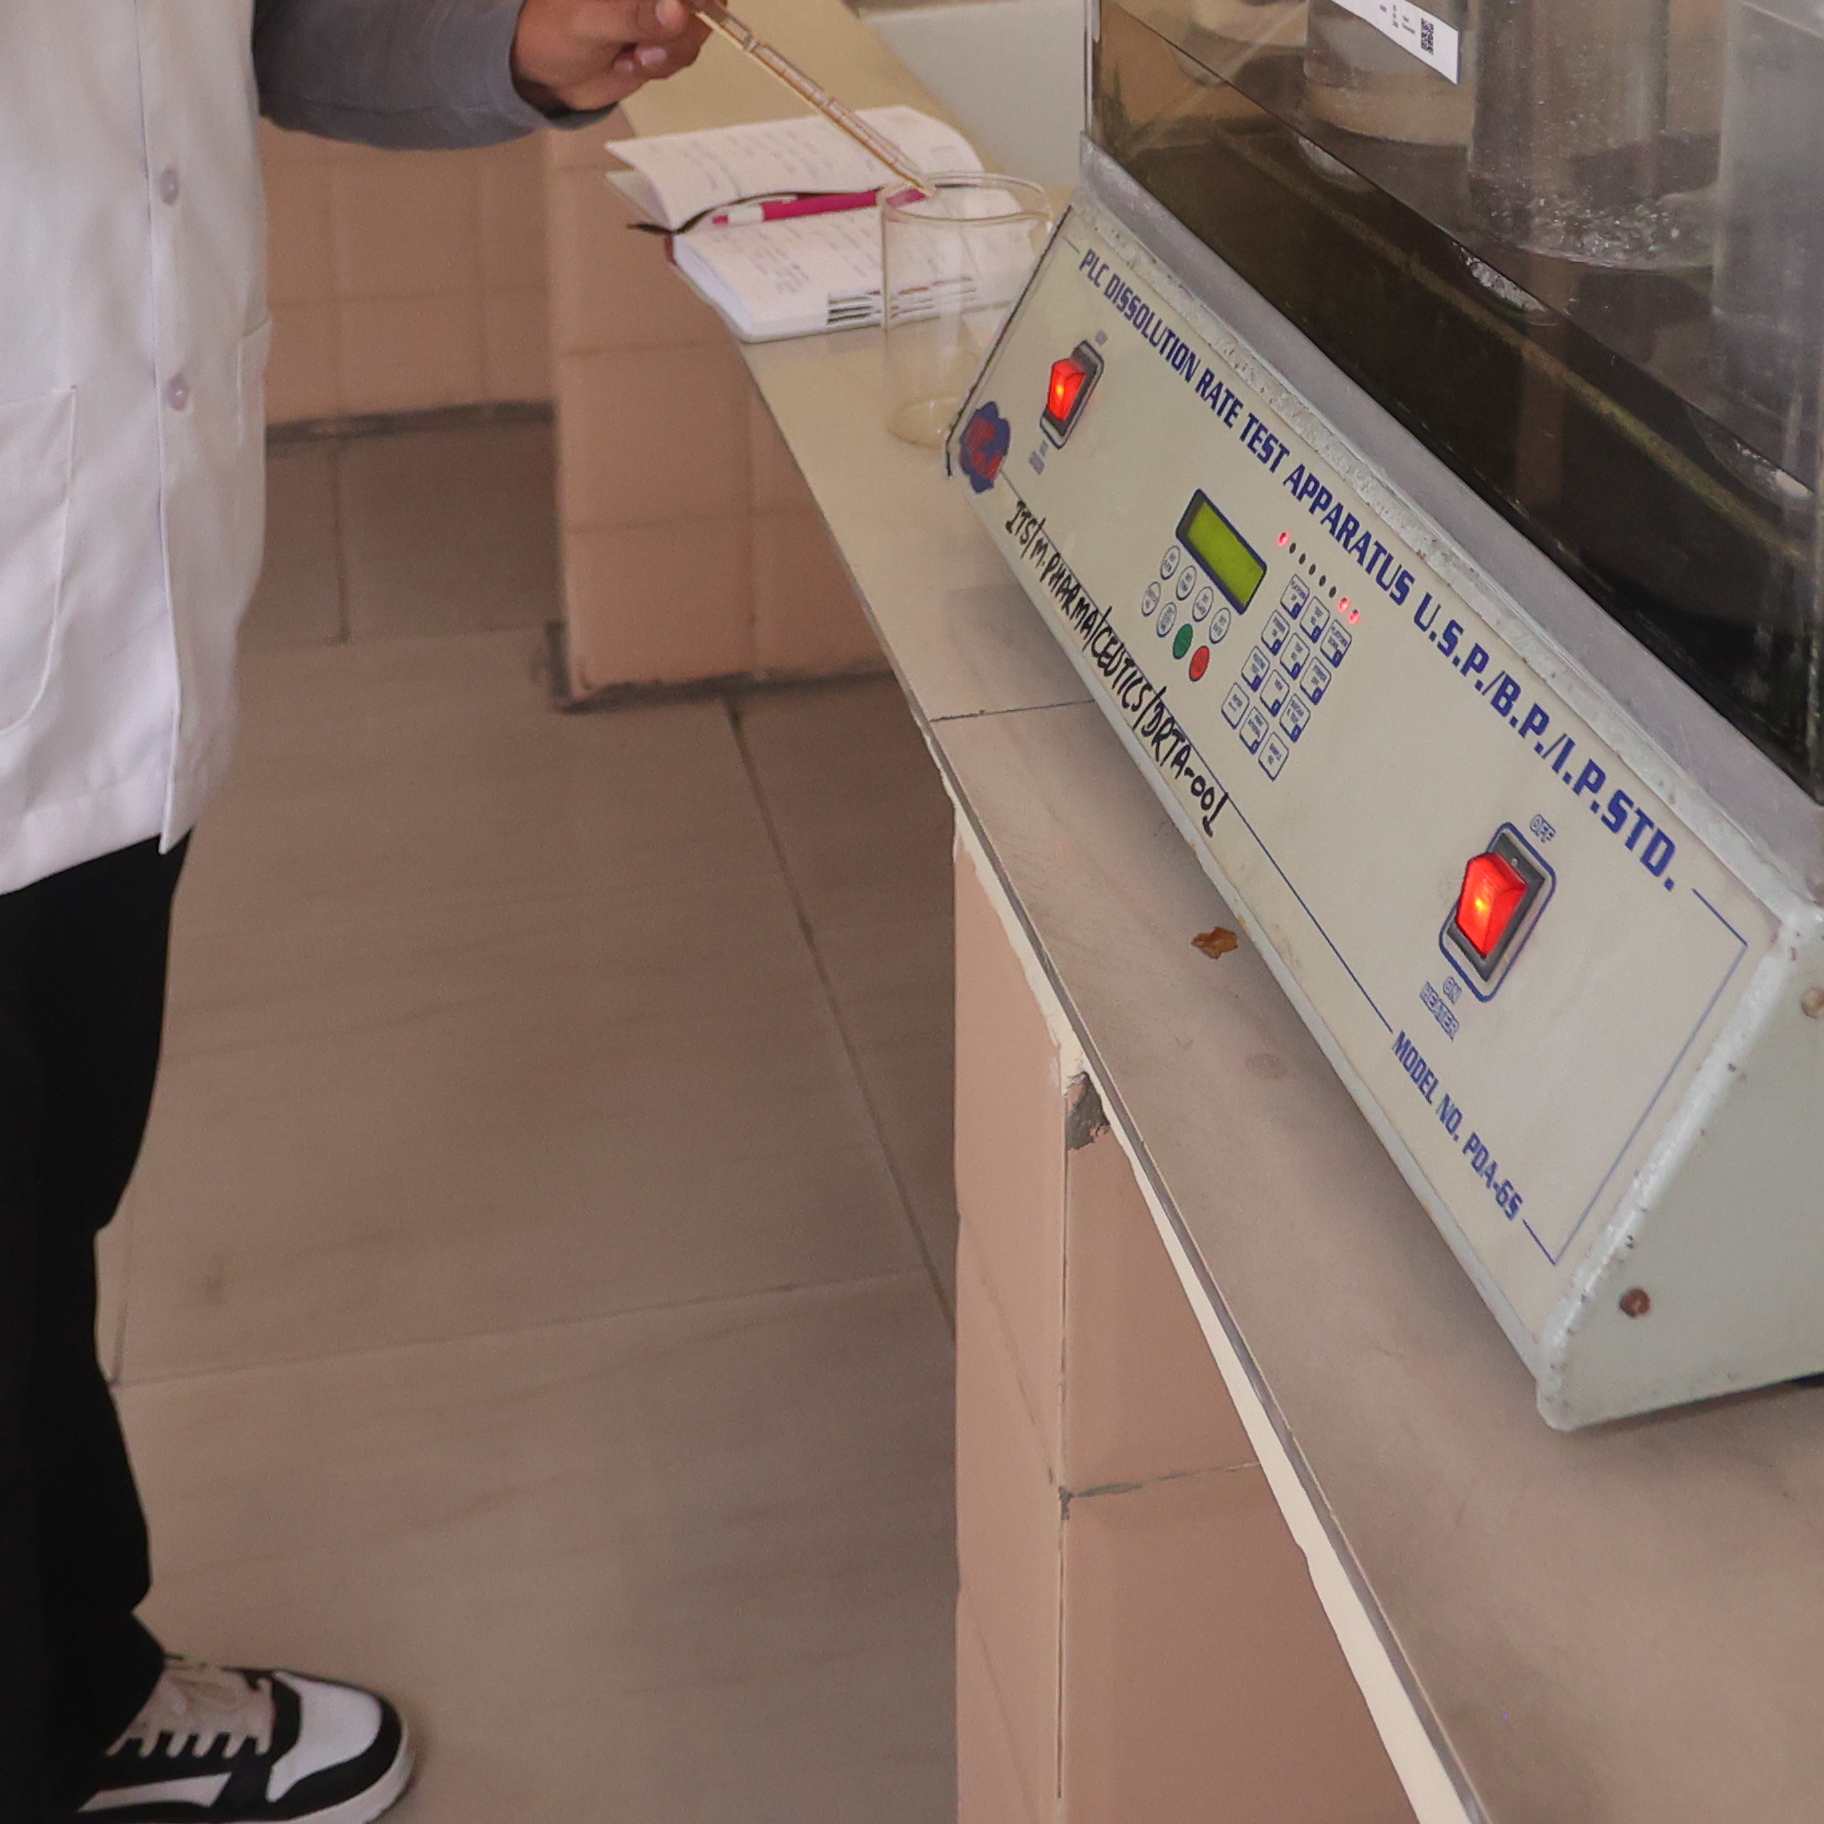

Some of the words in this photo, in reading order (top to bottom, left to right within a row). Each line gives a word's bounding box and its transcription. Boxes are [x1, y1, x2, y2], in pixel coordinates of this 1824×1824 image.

[1079, 248, 1110, 289] PLC
[1103, 273, 1202, 384] DISSOLUTION
[1194, 367, 1244, 429] RATE
[1239, 412, 1290, 473] TEST
[1282, 463, 1416, 607] APPARATUS
[1419, 980, 1460, 1043] HEATER
[1391, 1029, 1440, 1106] MODEL
[1435, 1092, 1463, 1143] NO.
